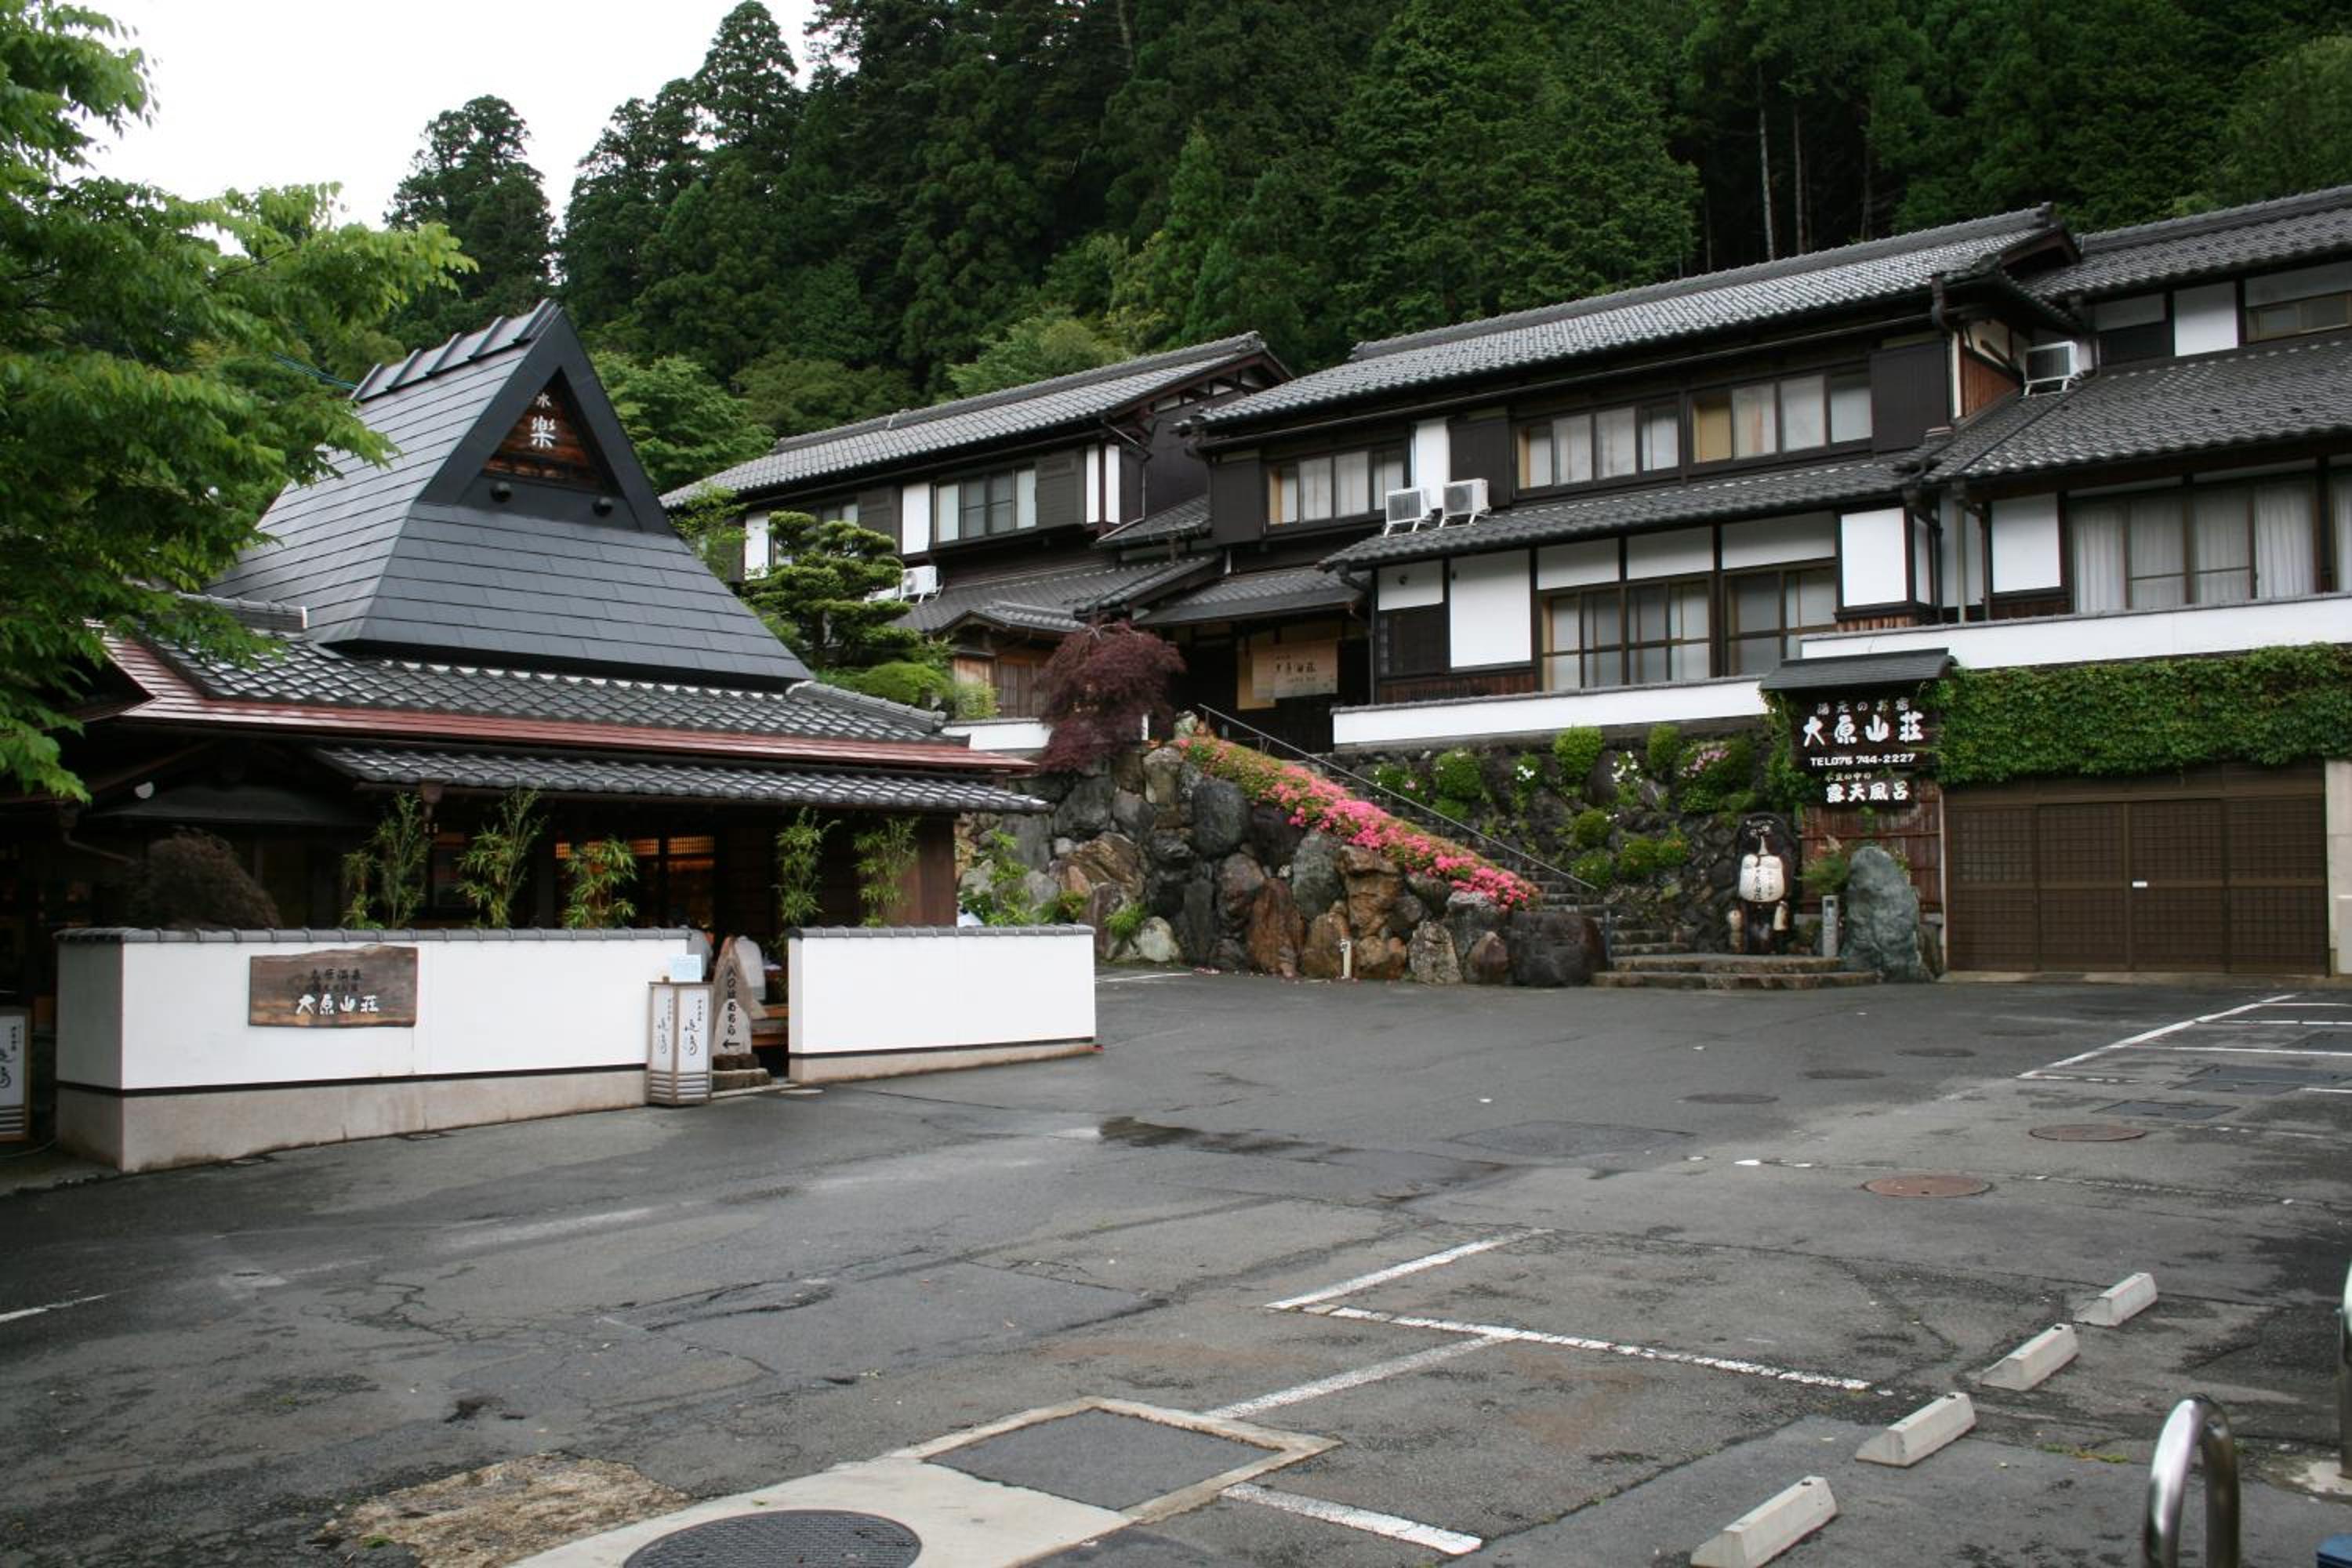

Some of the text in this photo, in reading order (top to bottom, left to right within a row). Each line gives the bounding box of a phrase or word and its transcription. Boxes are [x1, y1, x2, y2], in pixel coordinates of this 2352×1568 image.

[1803, 710, 1924, 747] 大原山荘
[1826, 780, 1909, 803] 露天風呂
[296, 993, 379, 1014] 大原山荘
